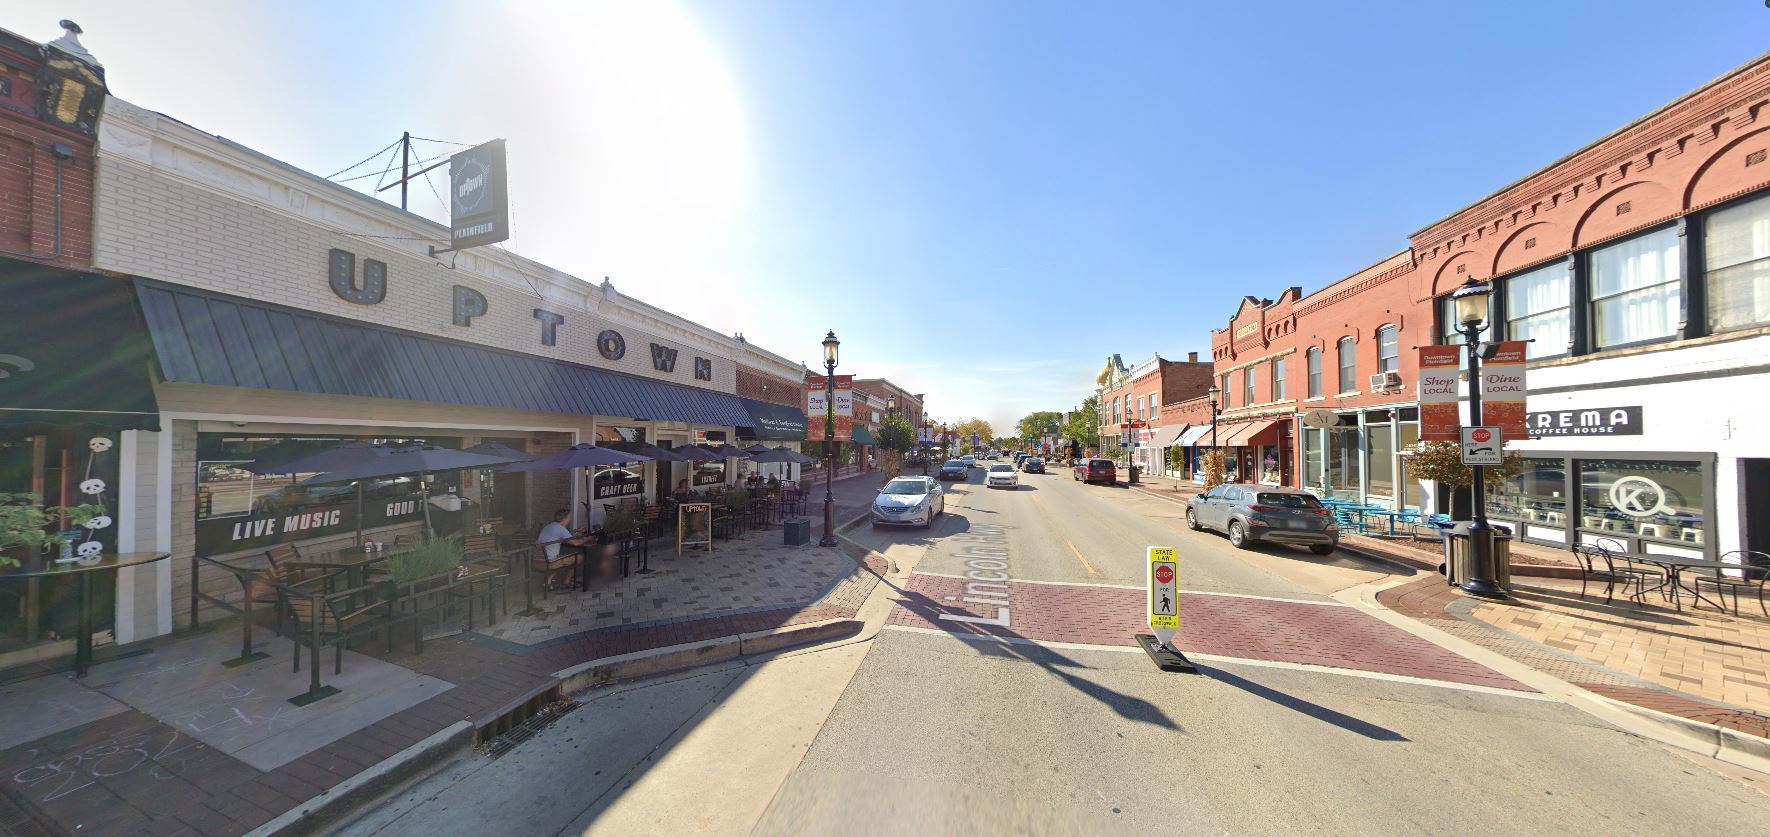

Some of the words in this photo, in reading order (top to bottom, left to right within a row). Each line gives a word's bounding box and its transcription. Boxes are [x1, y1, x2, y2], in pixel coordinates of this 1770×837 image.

[459, 173, 483, 198] UPTOWN
[454, 222, 494, 239] PLAINFIELD
[328, 247, 711, 382] UPTOWN
[1423, 376, 1455, 388] Shop
[1486, 374, 1521, 384] Dine
[1423, 387, 1455, 395] LOCAL
[1486, 385, 1522, 393] LOCAL
[600, 484, 622, 497] CRAFT
[622, 483, 638, 494] BEER
[1619, 486, 1644, 511] K
[386, 500, 415, 517] GOOD
[232, 518, 277, 541] LIVE
[283, 510, 341, 533] MUSIC
